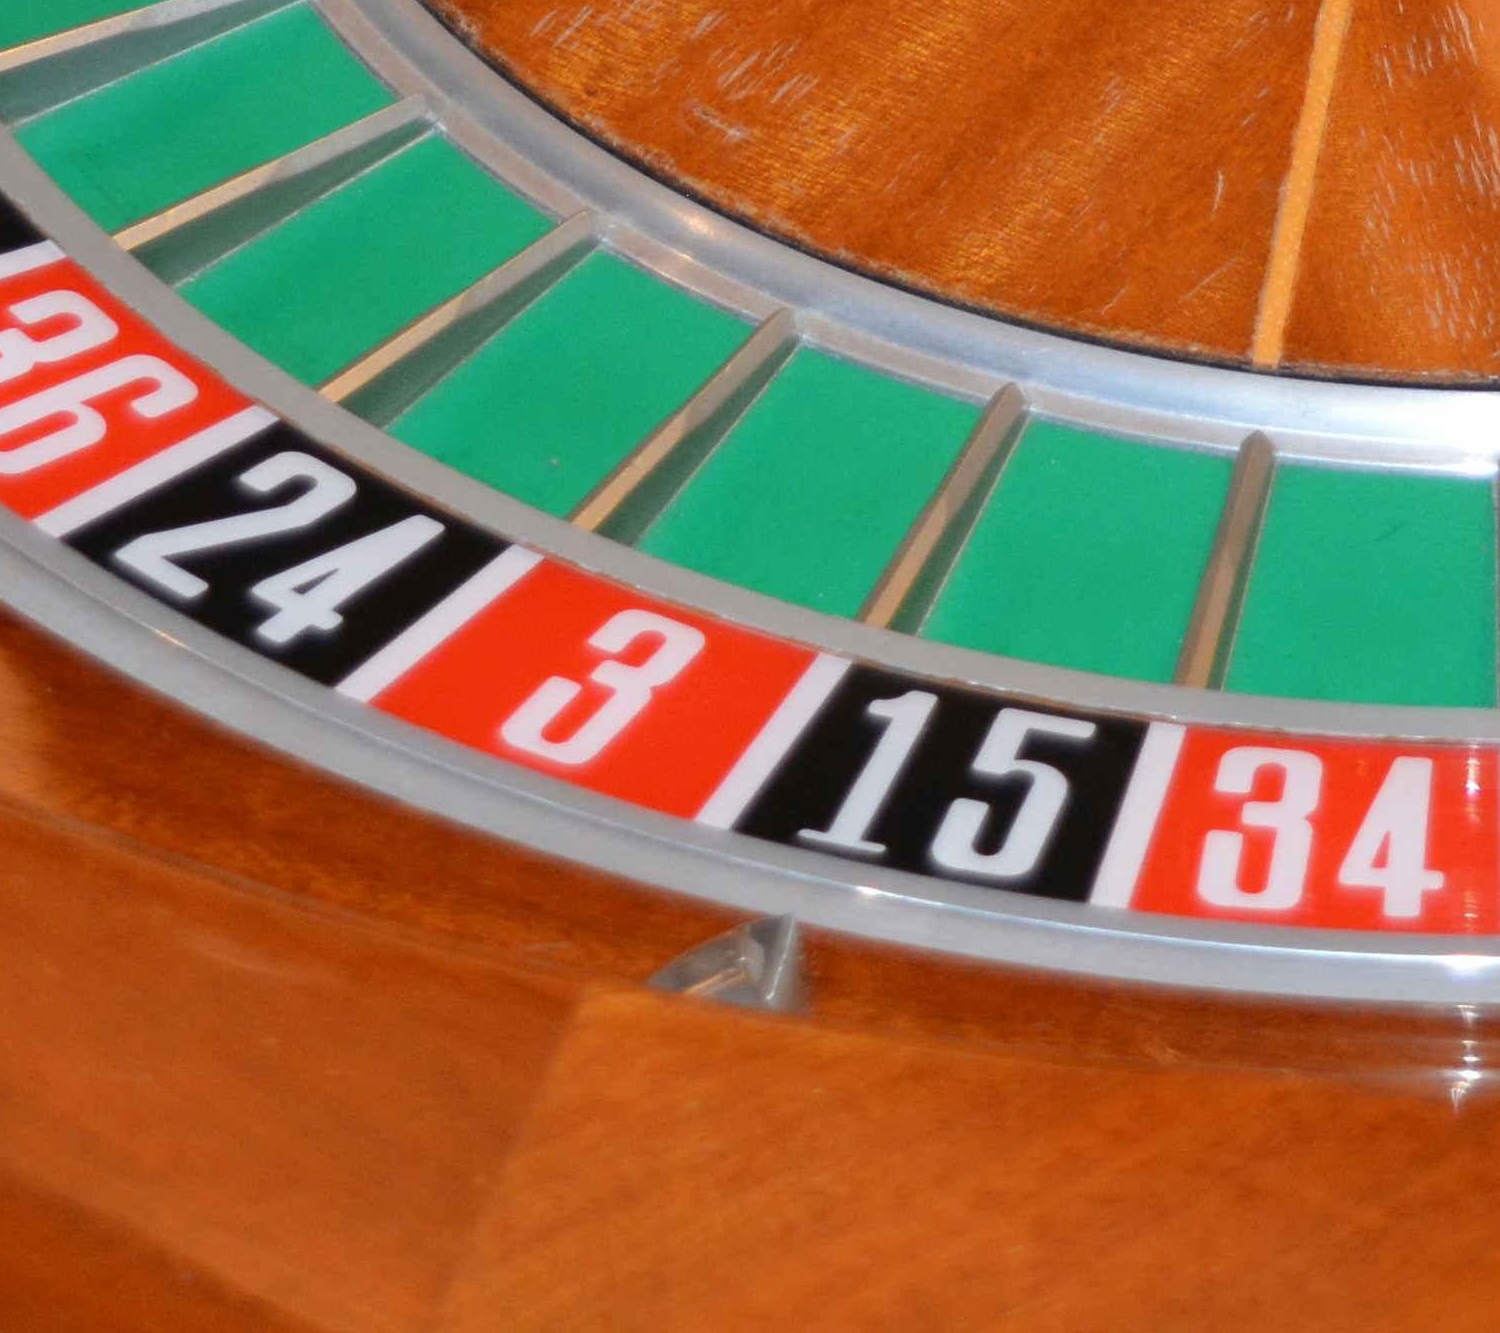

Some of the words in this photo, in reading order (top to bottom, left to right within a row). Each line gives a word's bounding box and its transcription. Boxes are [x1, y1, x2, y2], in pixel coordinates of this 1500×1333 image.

[113, 450, 446, 645] 24
[498, 608, 707, 768] 3
[797, 689, 1097, 880] 15
[1195, 745, 1447, 922] 34
